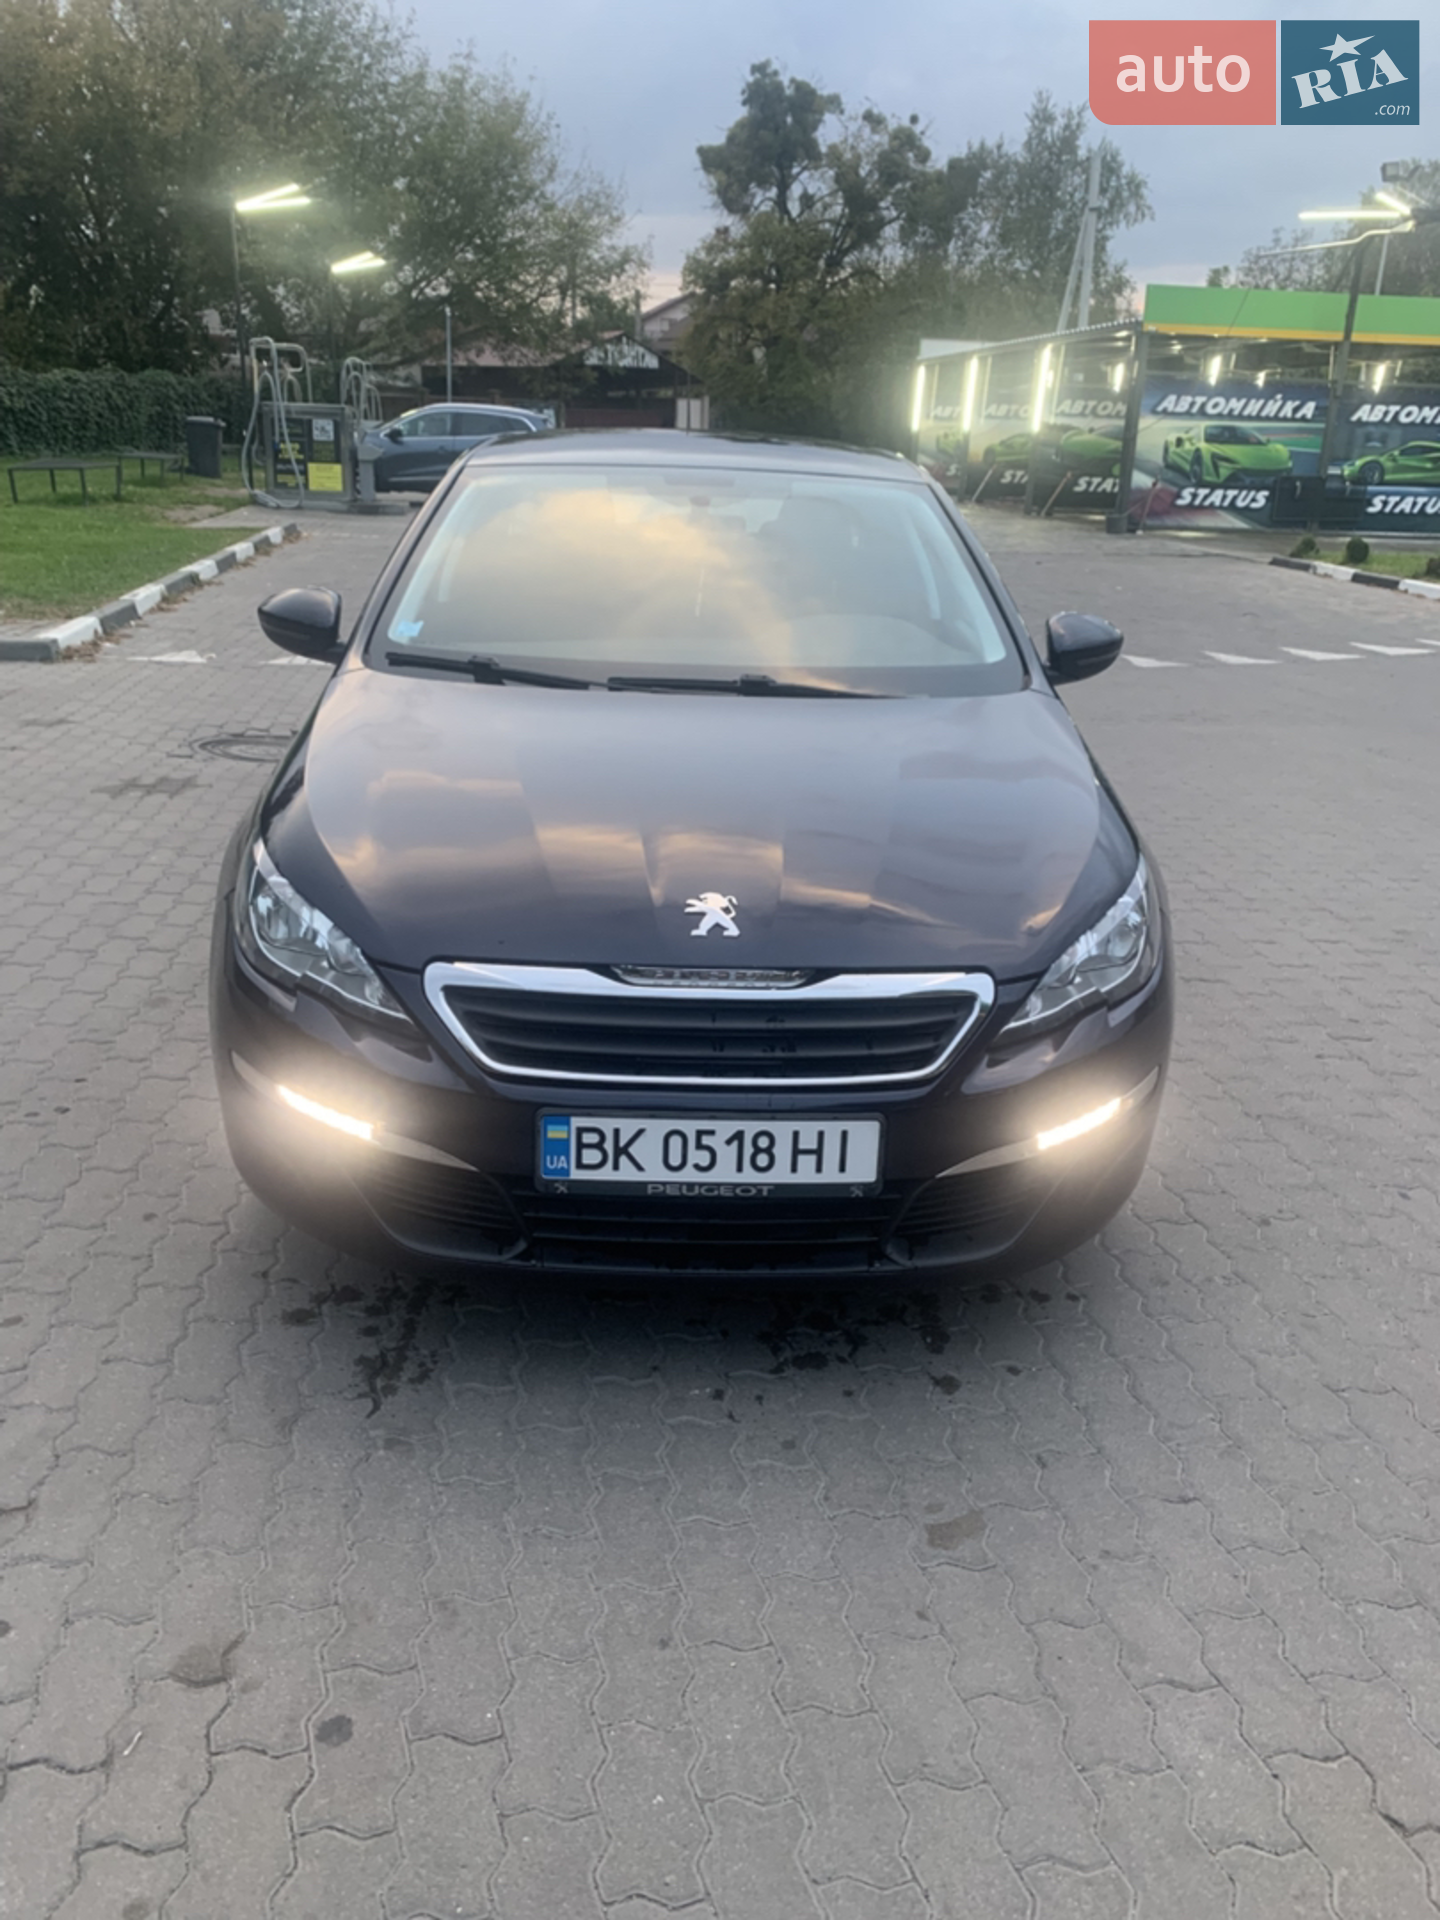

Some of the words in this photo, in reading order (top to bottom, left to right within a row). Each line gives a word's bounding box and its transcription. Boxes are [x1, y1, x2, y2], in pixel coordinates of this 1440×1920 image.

[1156, 393, 1317, 420] АВТОМИЙКА
[1350, 403, 1440, 424] АВТОМ
[1175, 486, 1270, 509] STATUS
[1366, 494, 1440, 515] STATU
[574, 1127, 647, 1172] BK
[661, 1129, 776, 1174] 0518
[790, 1130, 849, 1174] HI
[546, 1155, 568, 1169] UA
[646, 1183, 775, 1197] PEUGEOT
